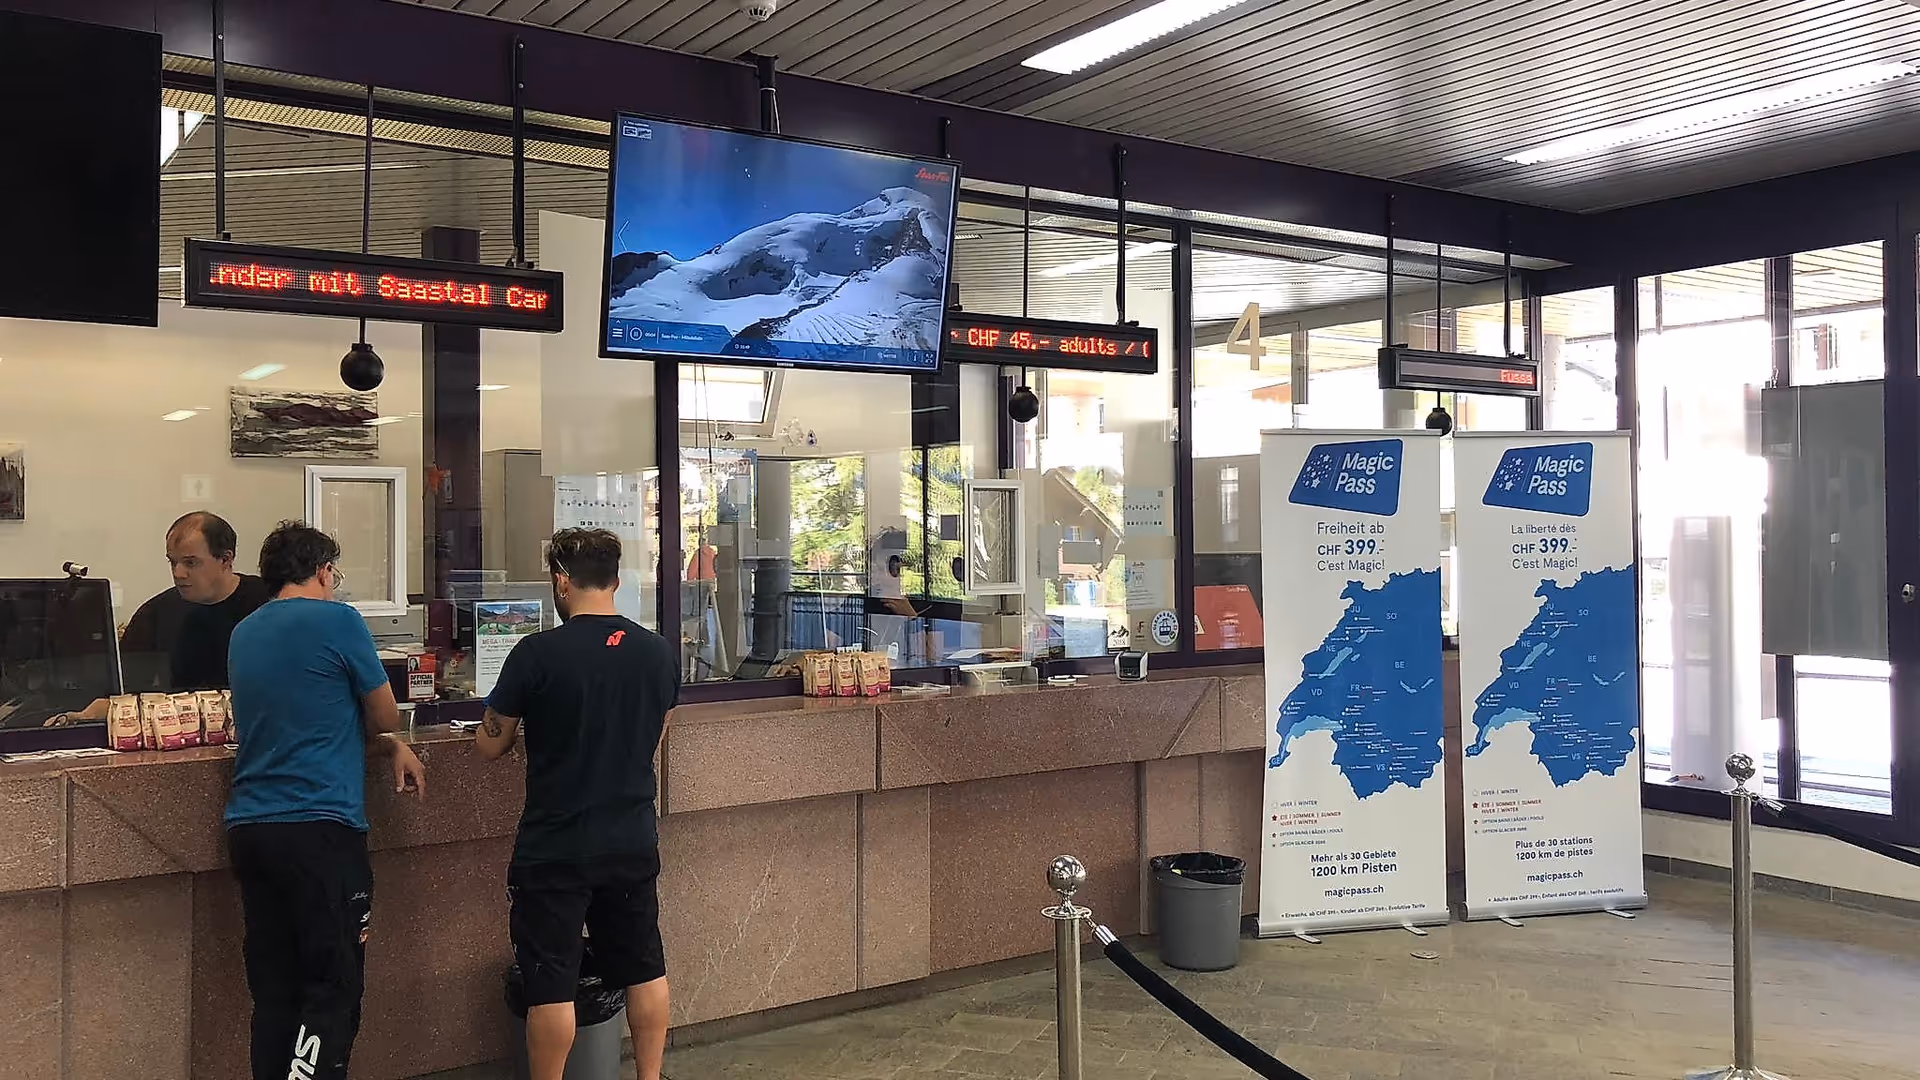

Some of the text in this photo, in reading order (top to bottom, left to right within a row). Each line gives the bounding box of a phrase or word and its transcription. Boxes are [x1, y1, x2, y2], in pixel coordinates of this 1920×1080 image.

[209, 263, 292, 289] nder
[309, 271, 361, 296] mit
[378, 275, 489, 306] Saastal
[967, 328, 1000, 347] CHF
[1009, 332, 1050, 350] 45.-
[1059, 337, 1116, 355] adults
[1227, 302, 1266, 371] 4
[1342, 451, 1394, 475] Magic
[1534, 454, 1585, 477] Magic
[1334, 472, 1376, 494] Pass
[1527, 475, 1568, 496] Pass
[1317, 522, 1385, 534] Freiheit ab
[1511, 523, 1576, 534] La liberté dès
[1317, 545, 1341, 555] CHF
[1512, 544, 1536, 554] CHF
[1317, 559, 1385, 573] C'est Magic!
[1512, 557, 1578, 572] C'est Magic!
[1350, 605, 1361, 613] JU
[1386, 612, 1397, 620] SO
[1311, 688, 1323, 696] VD
[1350, 684, 1361, 692] FR
[1515, 836, 1593, 849] Plus de 30 stations
[1311, 850, 1397, 863] Mehr als 30 Gebiete
[1516, 848, 1593, 861] 1200 km de pistes
[1311, 862, 1397, 877] 1200 km Pisten
[1527, 870, 1583, 882] magicpass.ch
[1324, 885, 1384, 898] magicpass.ch
